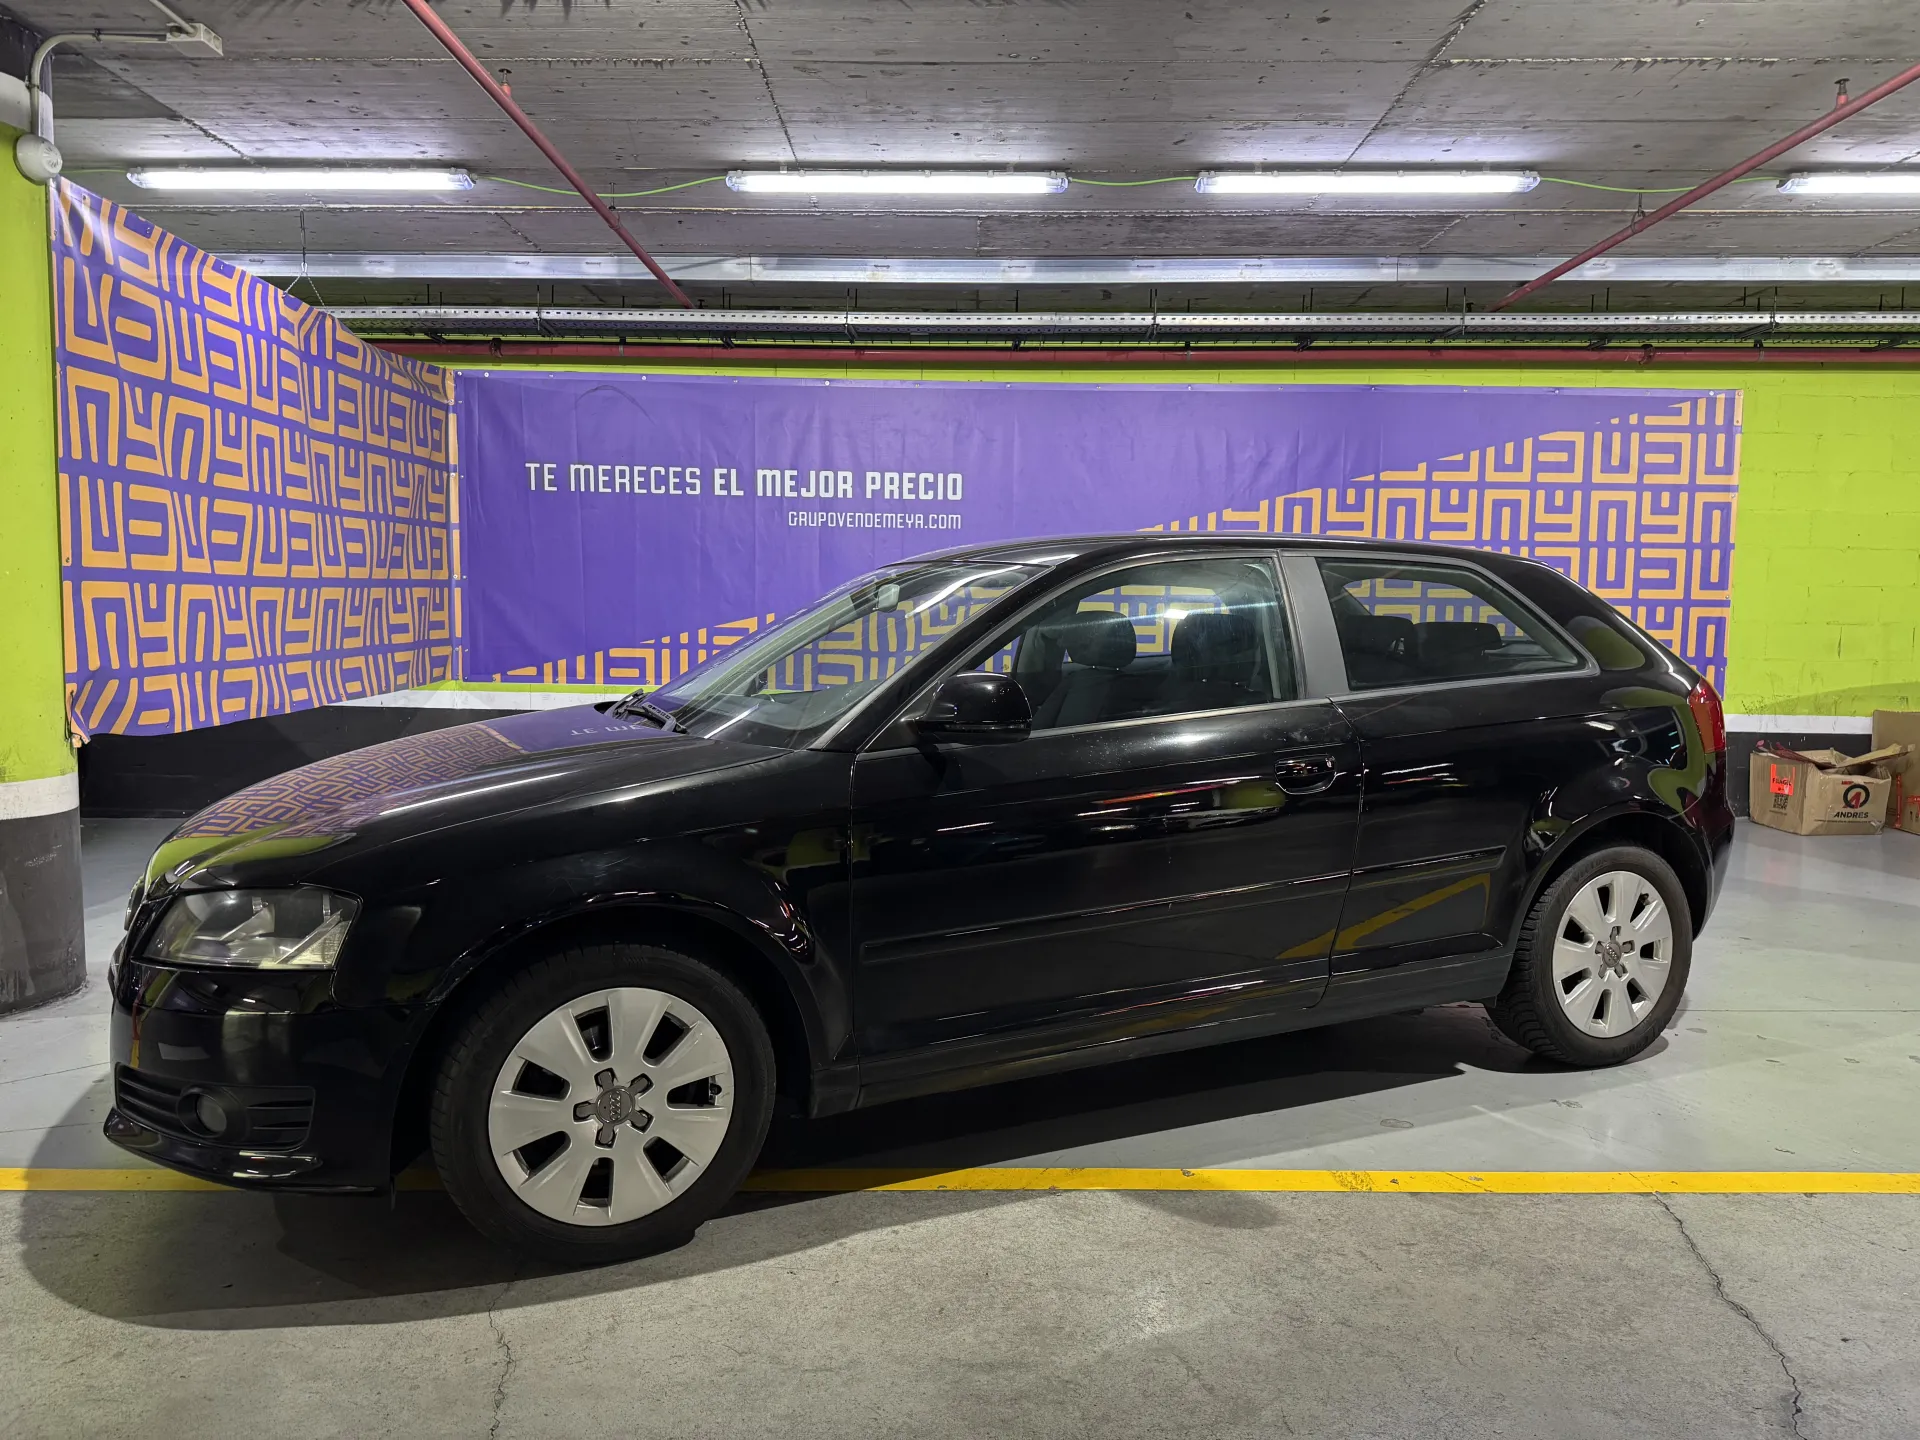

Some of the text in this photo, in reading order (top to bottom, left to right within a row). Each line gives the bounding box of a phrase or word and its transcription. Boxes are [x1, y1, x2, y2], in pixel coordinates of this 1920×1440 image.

[525, 463, 963, 501] TE MERECES EL MEJOR PRECIO
[788, 511, 962, 530] GRUPOVENDEMEYA.COM
